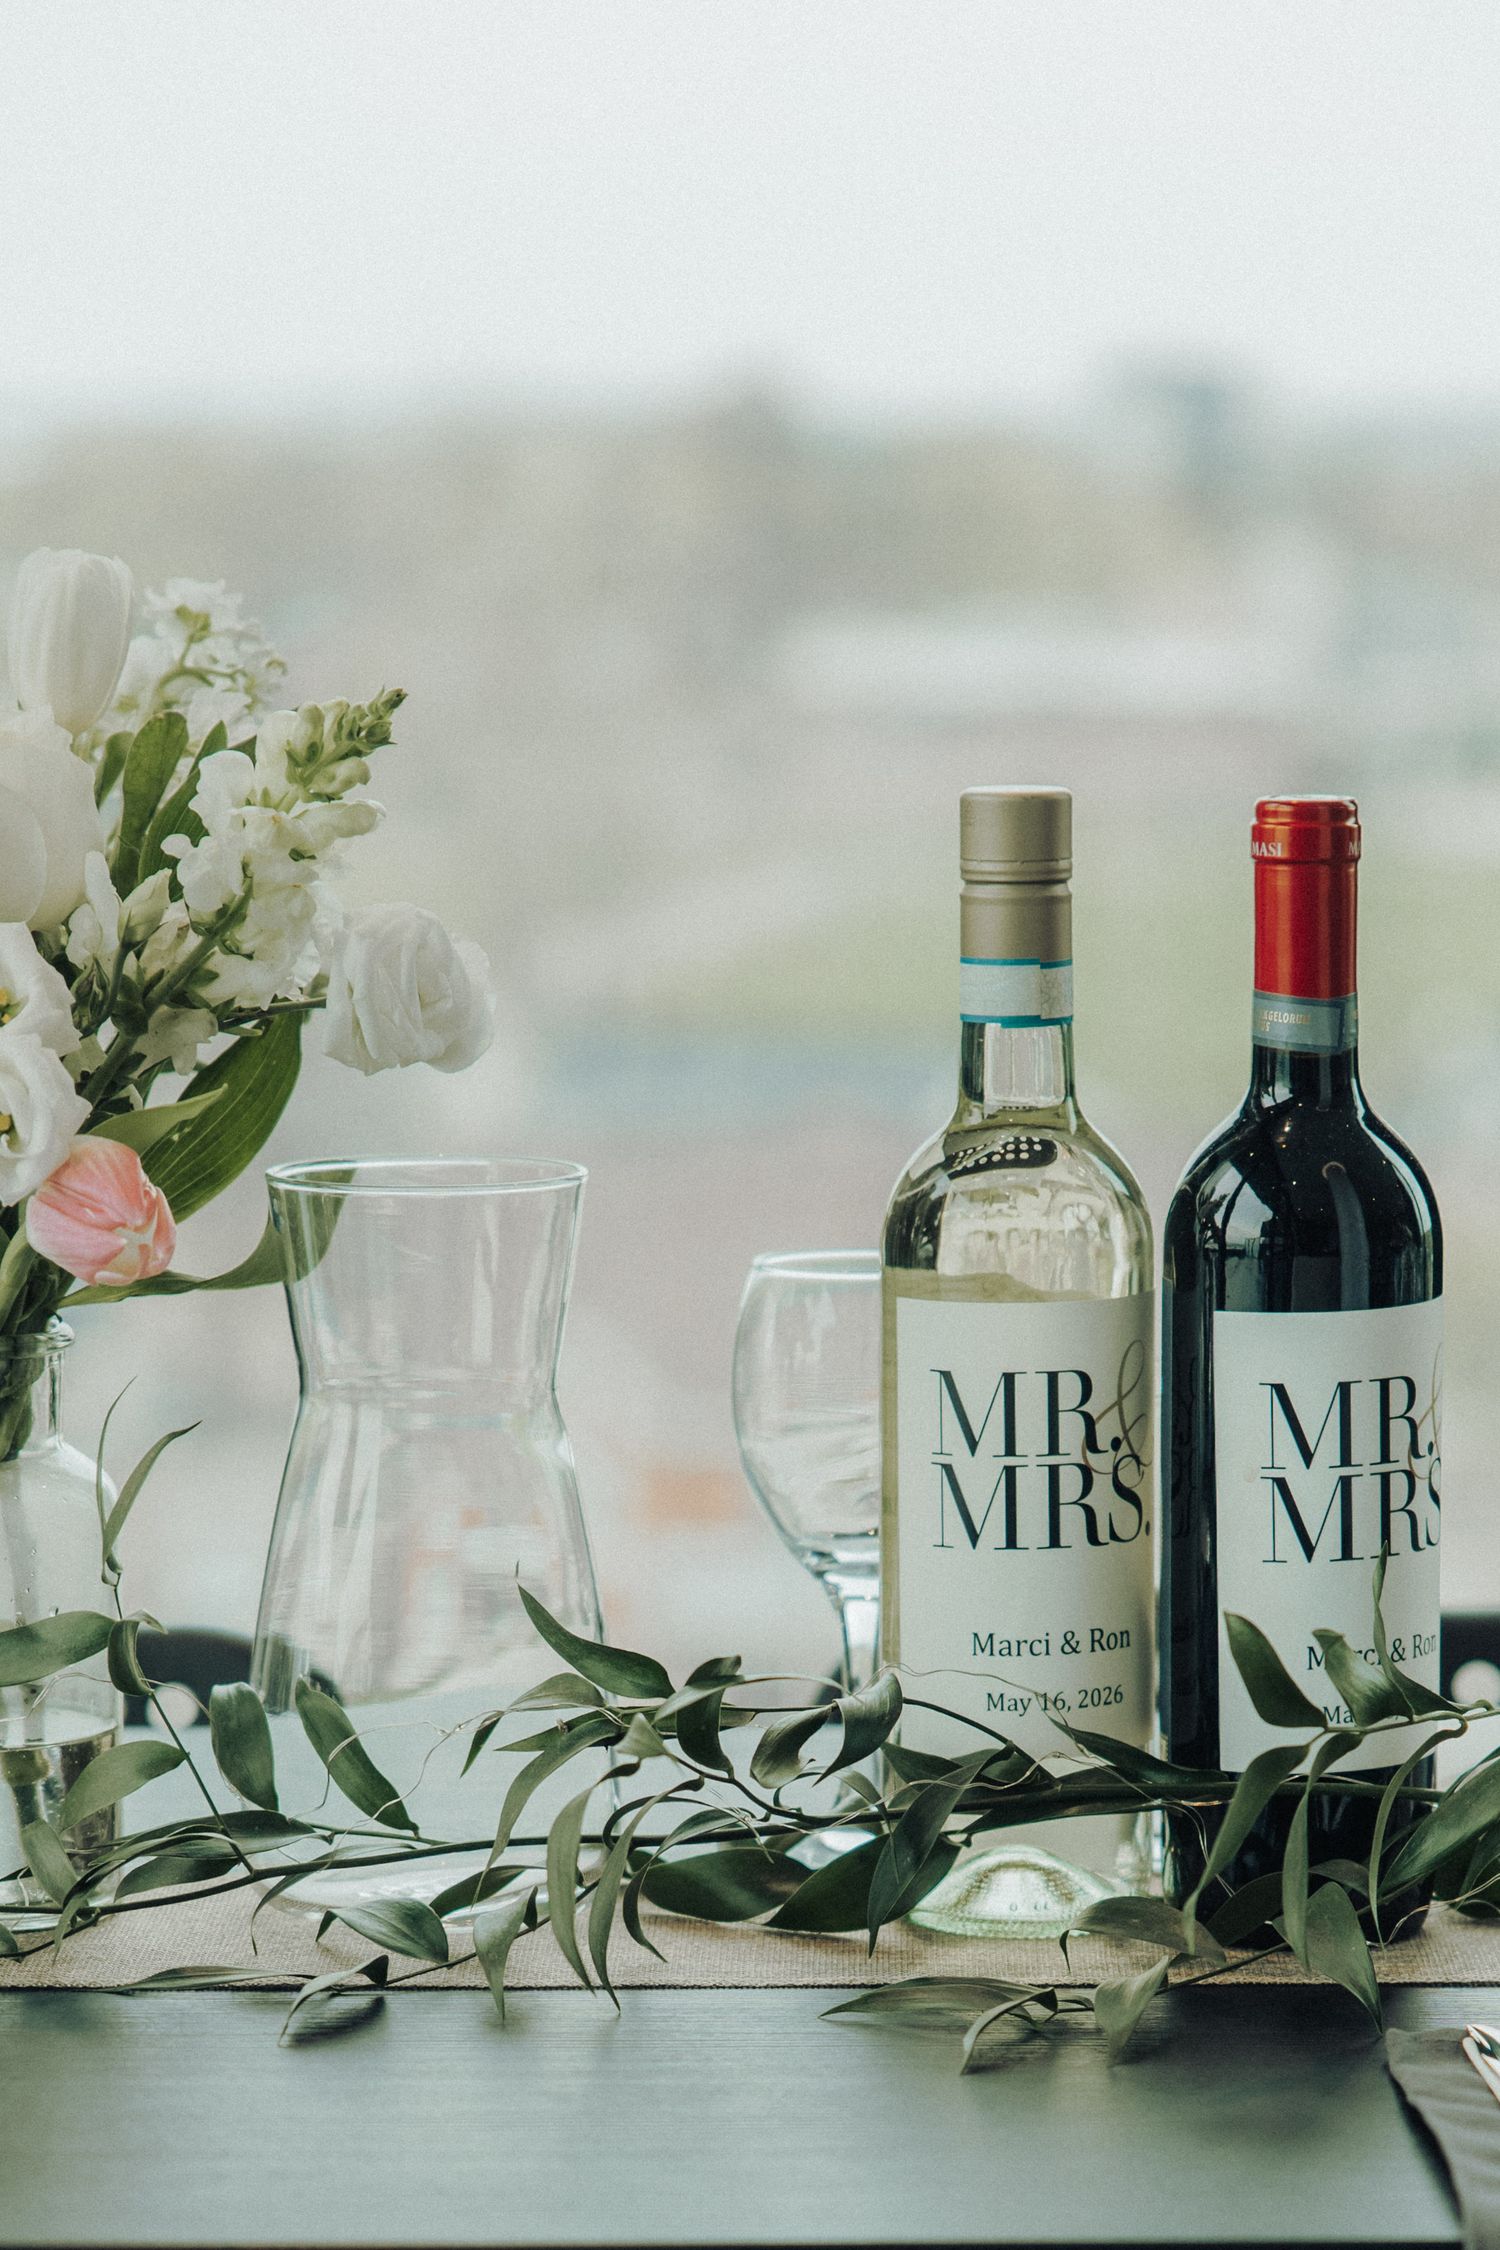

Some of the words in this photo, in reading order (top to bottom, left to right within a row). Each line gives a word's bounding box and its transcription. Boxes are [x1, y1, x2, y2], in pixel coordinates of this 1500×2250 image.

[1252, 841, 1282, 857] MASI
[930, 1369, 1122, 1458] MR.
[1081, 1339, 1153, 1489] &
[1259, 1375, 1434, 1471] MR.
[931, 1453, 1150, 1551] MRS.
[972, 1632, 1050, 1657] Marci
[1060, 1630, 1081, 1655] &
[1090, 1627, 1132, 1653] Ron
[1390, 1638, 1406, 1663] &
[986, 1692, 1032, 1717] May
[1041, 1691, 1072, 1713] 16,
[1078, 1684, 1124, 1709] 2026
[1323, 1705, 1354, 1725] Ma
